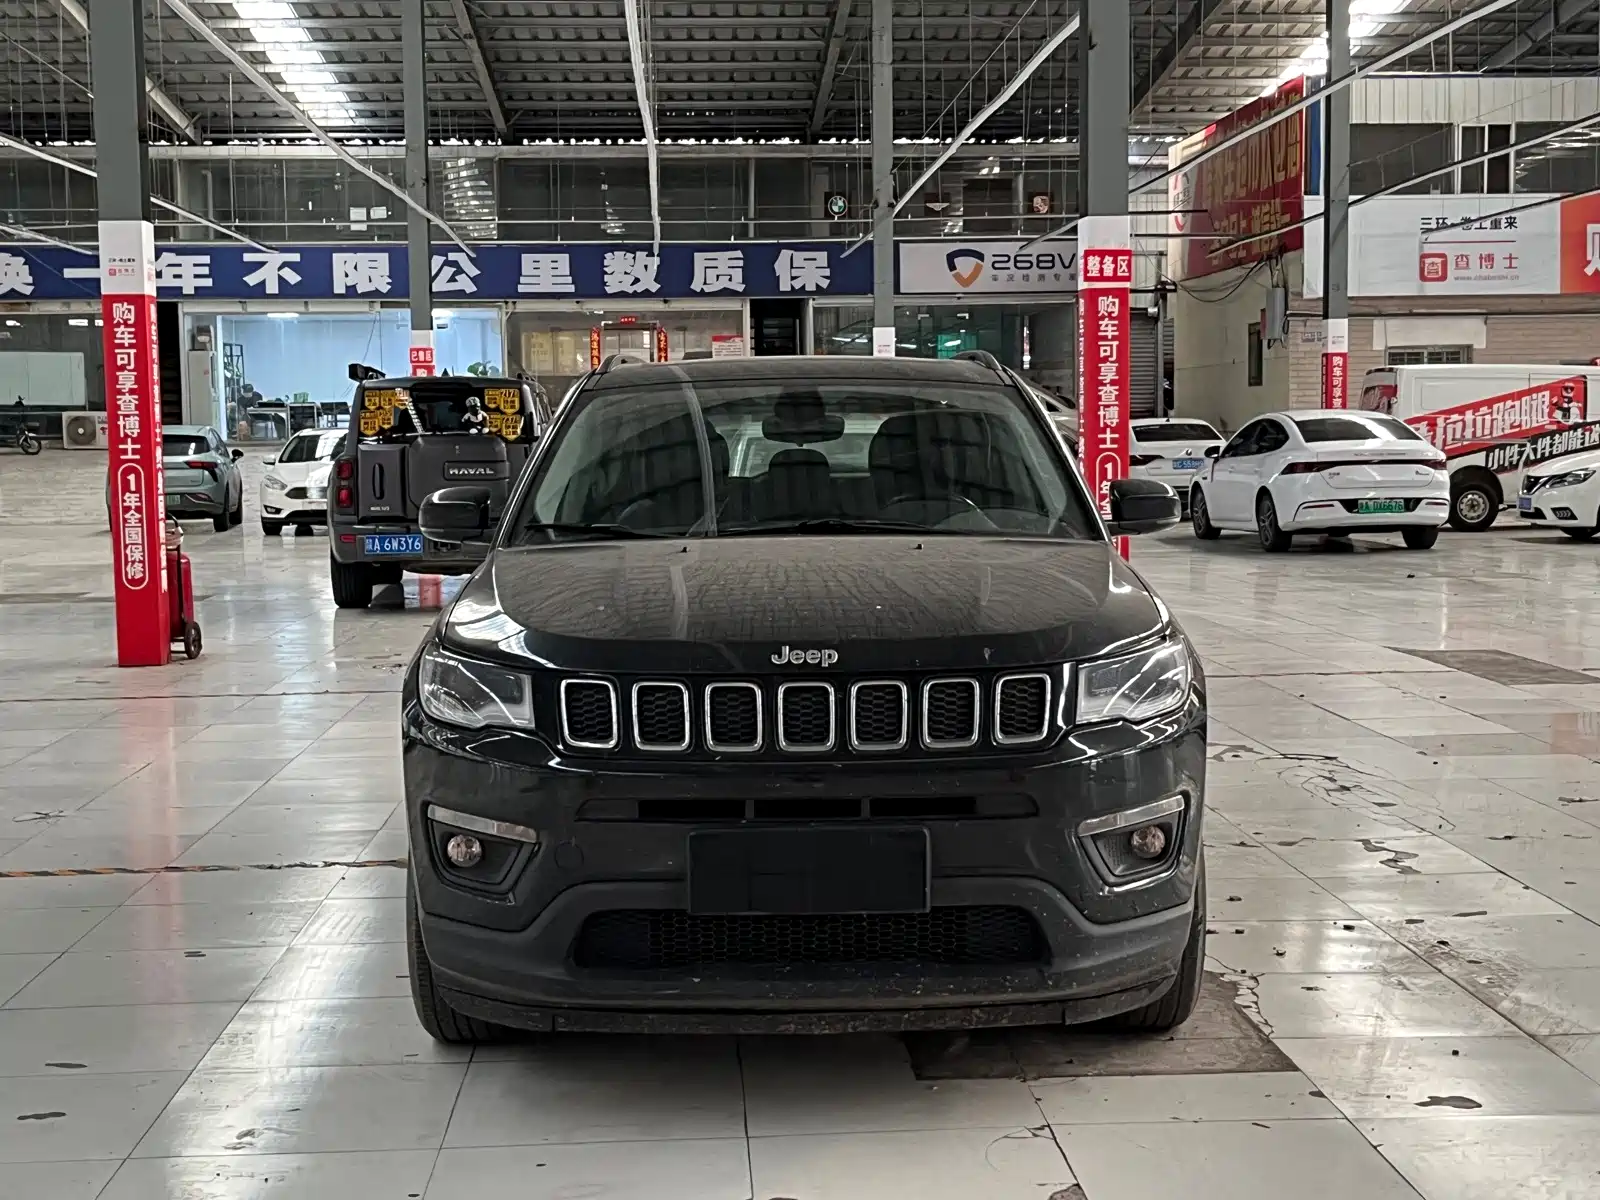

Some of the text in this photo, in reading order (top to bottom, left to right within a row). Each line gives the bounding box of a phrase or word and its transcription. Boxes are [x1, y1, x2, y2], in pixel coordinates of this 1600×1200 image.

[991, 253, 1076, 271] 268V
[1086, 255, 1130, 277] 整备区
[1453, 253, 1519, 270] 查博士
[112, 302, 141, 460] 购车可享查博士
[1097, 295, 1120, 449] 购车可享查博士
[123, 473, 145, 580] 1年全国保修
[771, 645, 839, 668] Jeep
